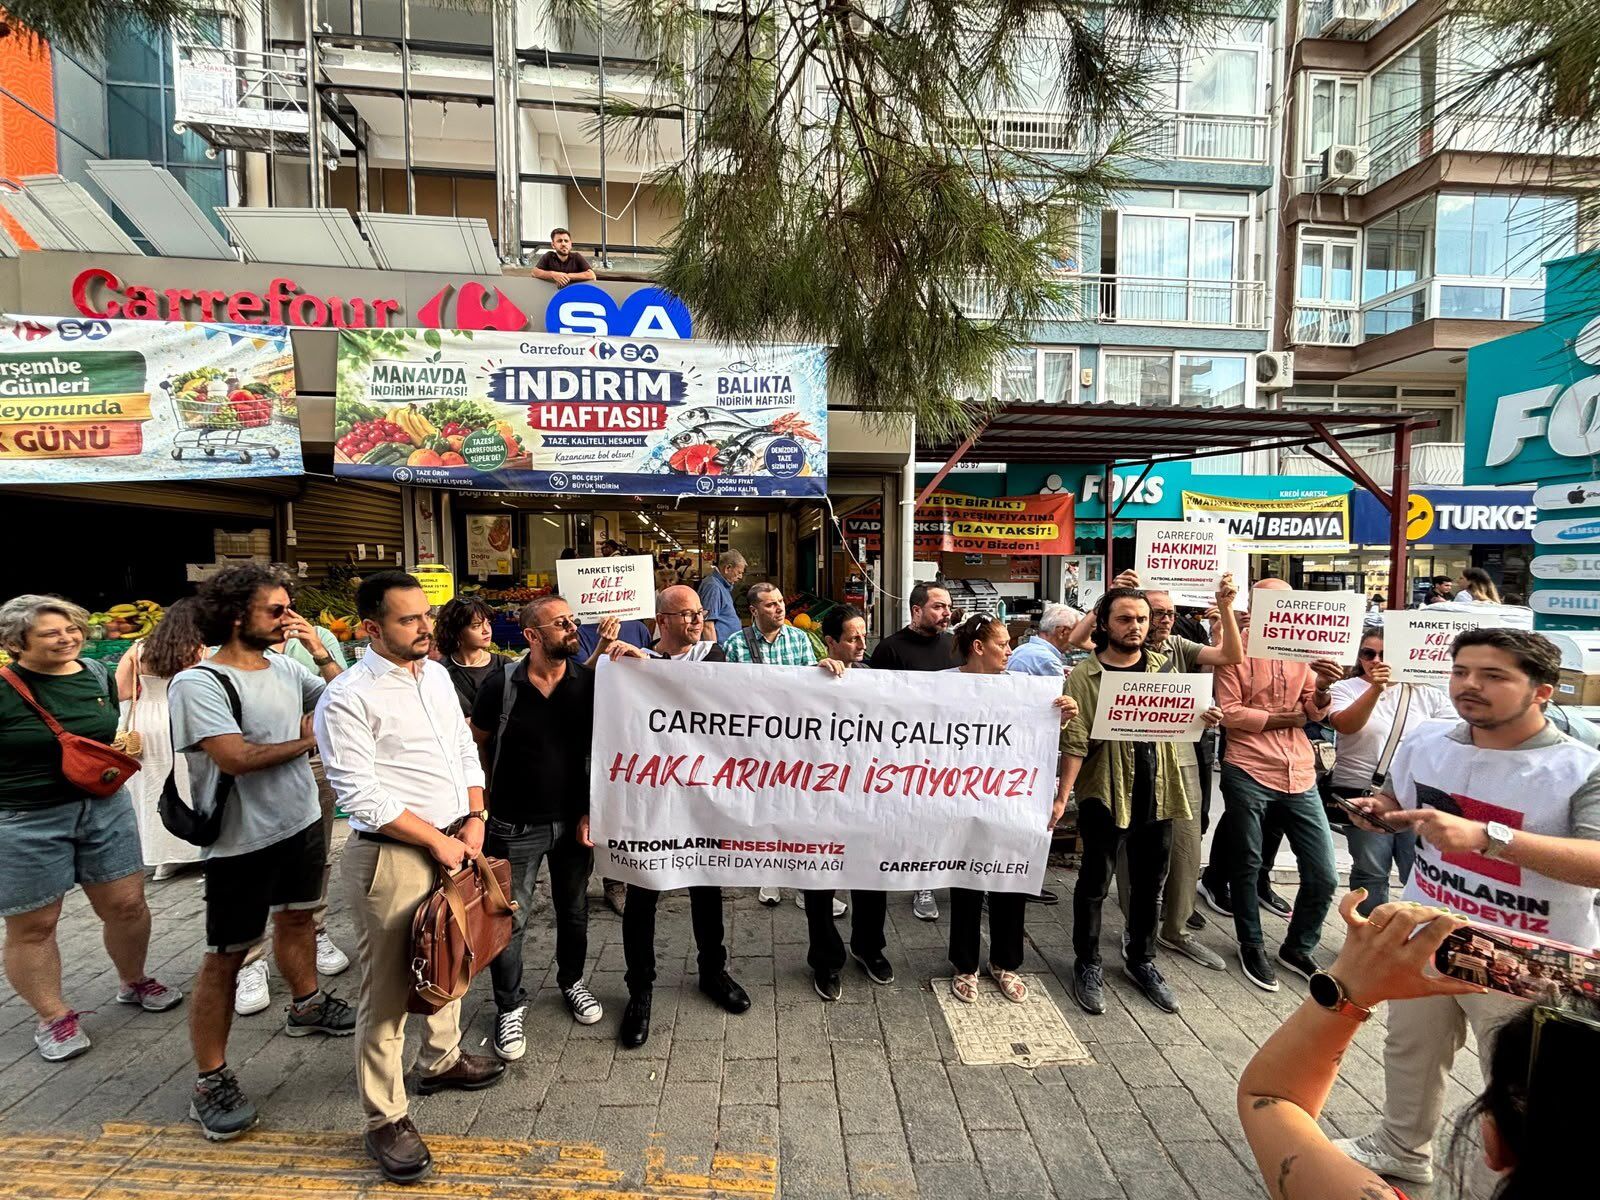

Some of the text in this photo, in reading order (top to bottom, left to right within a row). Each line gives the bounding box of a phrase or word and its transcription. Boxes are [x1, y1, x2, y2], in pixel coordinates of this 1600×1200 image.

[72, 269, 681, 339] Carrefour SA
[519, 342, 586, 356] Carrefour
[0, 357, 83, 378] rşembe
[372, 366, 467, 385] MANAVDA
[1, 376, 90, 396] Günleri
[371, 384, 468, 397] İNDİRİM HAFTASI!
[505, 368, 671, 402] İNDİRİM
[718, 375, 792, 395] BALIKTA
[716, 394, 795, 406] İNDİRİM HAFTASI!
[0, 399, 123, 421] eyonunda
[540, 405, 659, 429] HAFTASI!
[1485, 373, 1600, 467] FO
[13, 425, 111, 452] GÜNÜ
[548, 436, 642, 446] TAZE, KALİTELİ, HESAPLI!
[598, 450, 609, 460] bol
[611, 449, 635, 460] olsun!
[925, 495, 963, 507] YE'DE
[1434, 504, 1537, 531] TURKCE
[848, 521, 951, 532] VAD RKSIZ
[957, 524, 1052, 536] 12 AY TAKSİT!
[1267, 517, 1343, 537] BEDAVA
[1157, 530, 1214, 541] CARREFOUR
[953, 540, 986, 549] KDV
[987, 540, 1040, 550] Bizden!
[1151, 542, 1217, 556] HAKKIMIZI
[578, 564, 635, 575] MARKET İŞÇİSİ
[1147, 554, 1219, 571] İSTİYORUZ!
[592, 575, 624, 589] KÖLE
[581, 588, 636, 604] DEĞİLDİR!
[1548, 596, 1600, 610] PHILI
[1276, 599, 1347, 612] CARREFOUR
[1269, 611, 1350, 628] HAKKIMIZI
[1409, 621, 1451, 630] MARKET
[1263, 624, 1351, 644] İSTİYORUZ!
[1425, 632, 1453, 646] KÖL
[1409, 647, 1451, 661] DEĞİL
[1122, 682, 1192, 694] CARREFOUR
[1115, 694, 1195, 709] HAKKIMIZI
[1108, 706, 1195, 723] İSTİYORUZ!
[649, 709, 1012, 751] CARREFOUR İÇİN ÇALIŞTIK
[609, 752, 1039, 801] HAKLARIMIZI İSTİYORUZ!
[610, 852, 844, 871] MARKET İŞÇİLERİ DAYANIŞMA AĞI
[879, 858, 1030, 875] CARREFOUR İŞÇİLERİ
